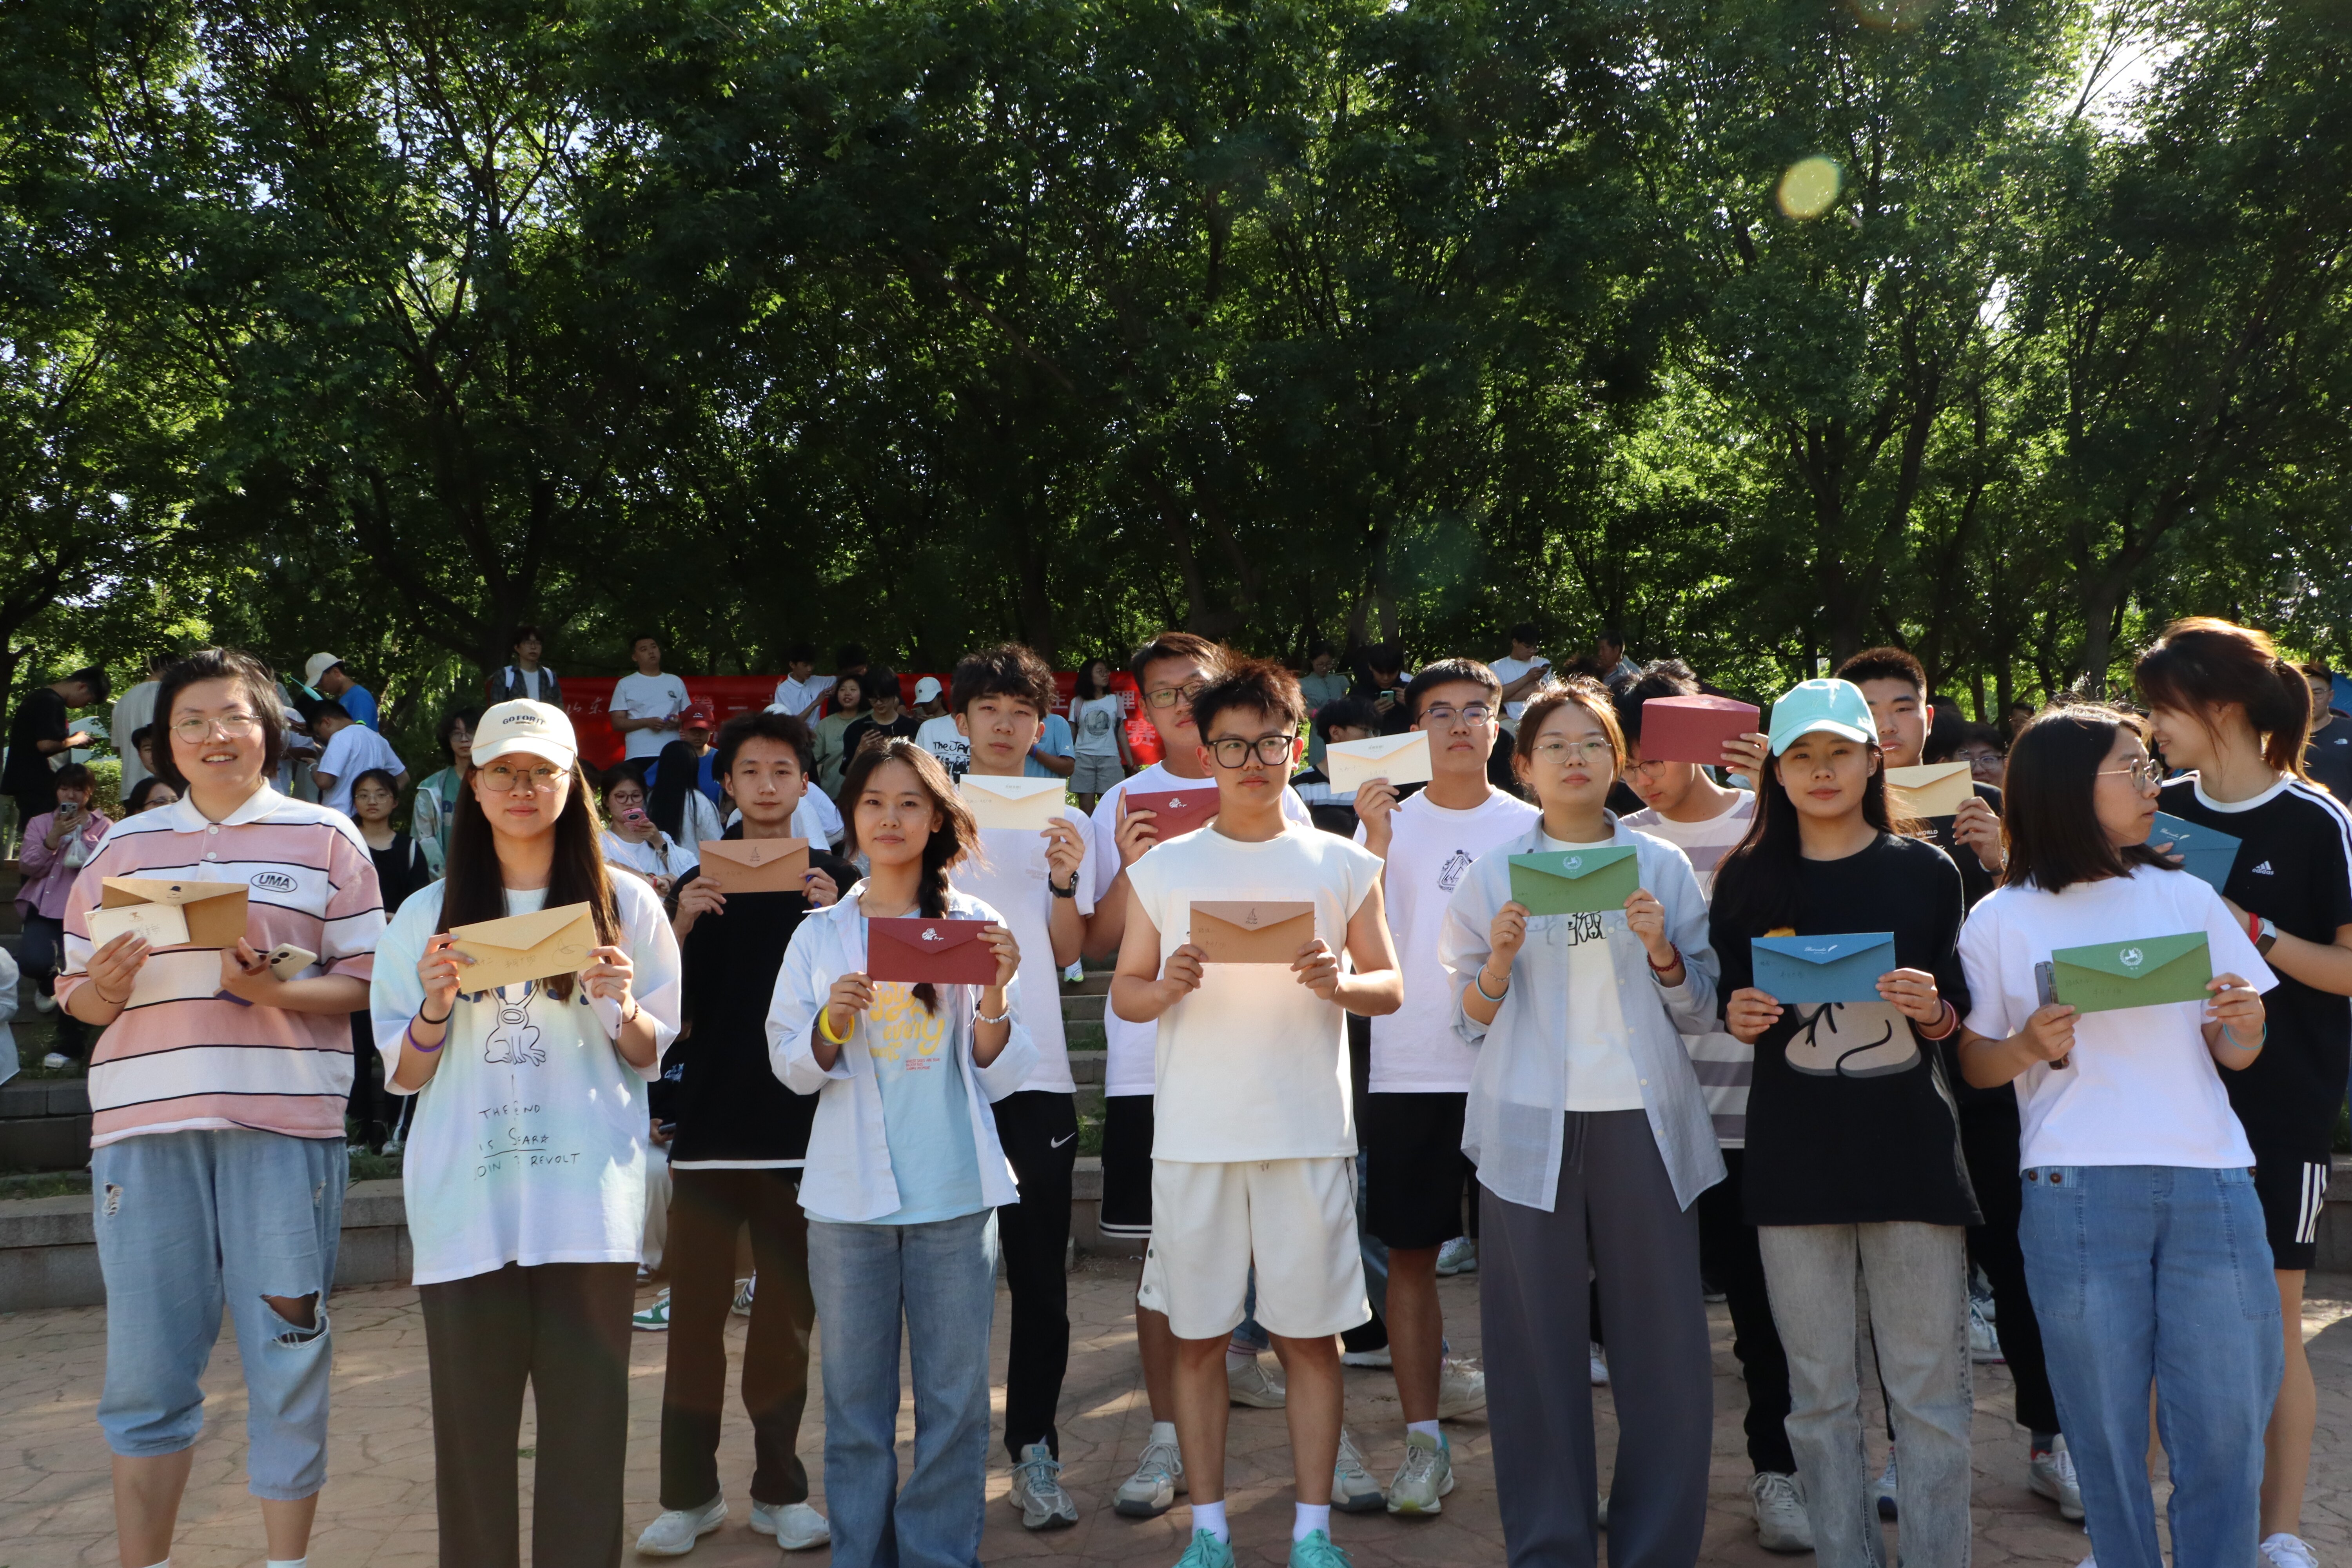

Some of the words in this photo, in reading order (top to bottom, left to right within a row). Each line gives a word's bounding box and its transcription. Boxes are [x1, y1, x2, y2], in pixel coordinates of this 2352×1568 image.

[503, 716, 515, 724] GO
[933, 741, 949, 751] The
[259, 874, 290, 889] UMA
[479, 1104, 508, 1119] THE
[479, 1140, 493, 1151] IS
[531, 1152, 580, 1166] REVOLT
